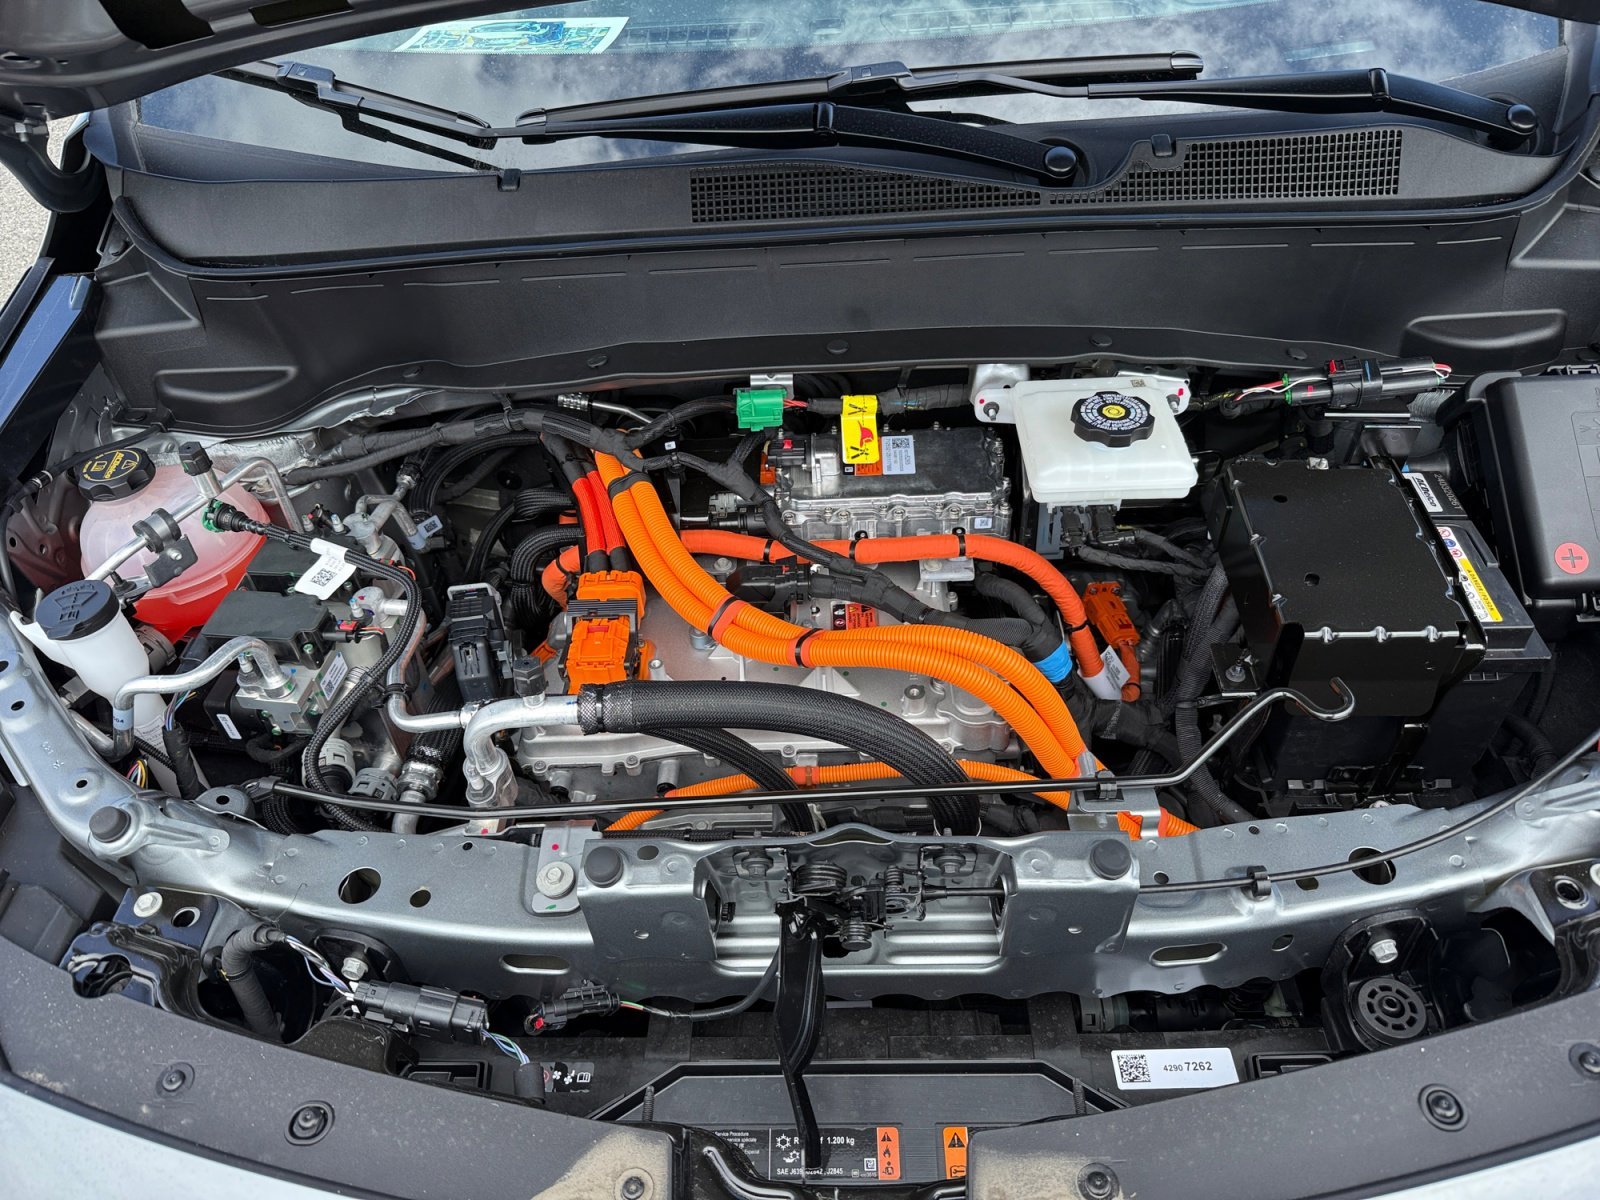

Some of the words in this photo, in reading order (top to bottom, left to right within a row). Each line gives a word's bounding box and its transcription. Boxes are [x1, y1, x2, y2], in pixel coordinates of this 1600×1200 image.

[1415, 477, 1437, 507] ACDelco
[1184, 1061, 1213, 1071] 7262
[827, 1136, 845, 1145] 1.200
[846, 1136, 855, 1146] kg
[776, 1167, 789, 1175] SAE
